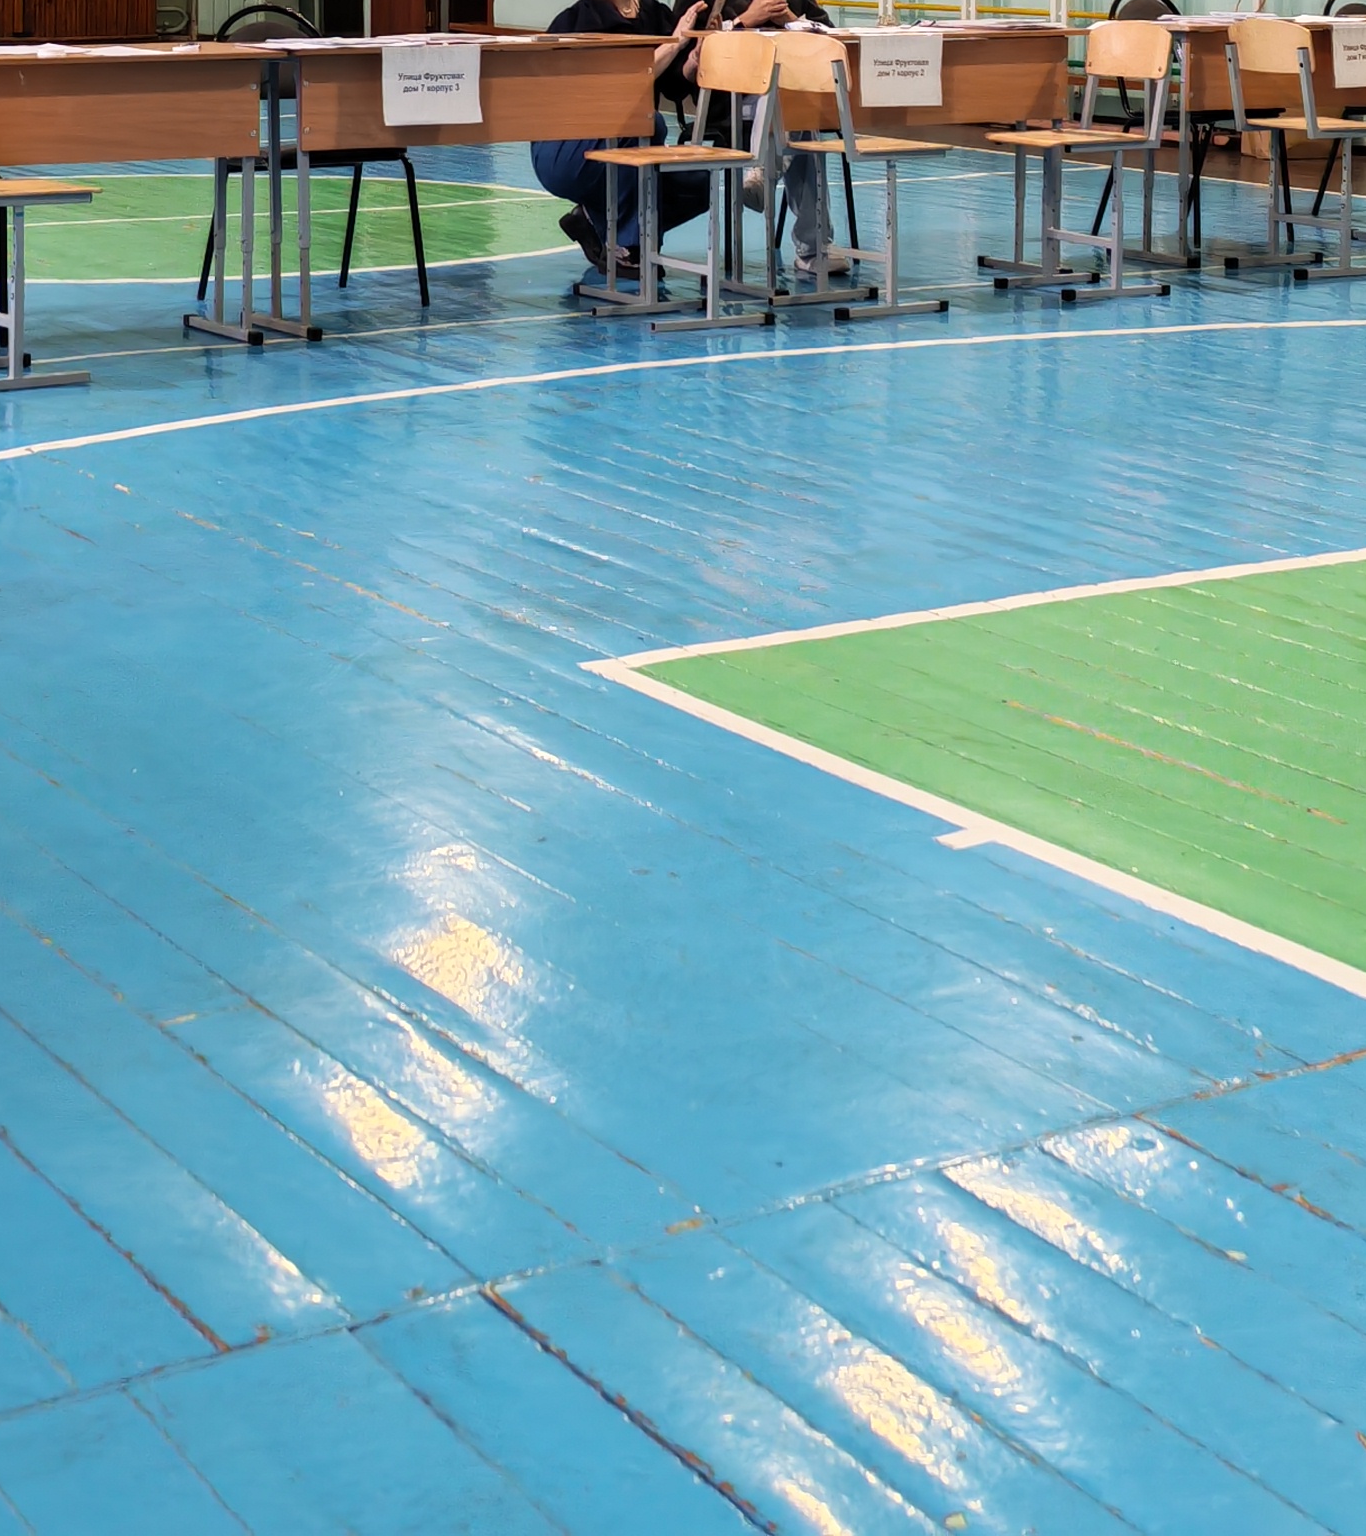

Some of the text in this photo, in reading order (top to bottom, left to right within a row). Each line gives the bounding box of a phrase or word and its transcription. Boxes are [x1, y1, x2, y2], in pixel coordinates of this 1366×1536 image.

[398, 72, 465, 82] Улица Фруктовая
[403, 85, 419, 93] дом
[427, 84, 453, 93] корпус
